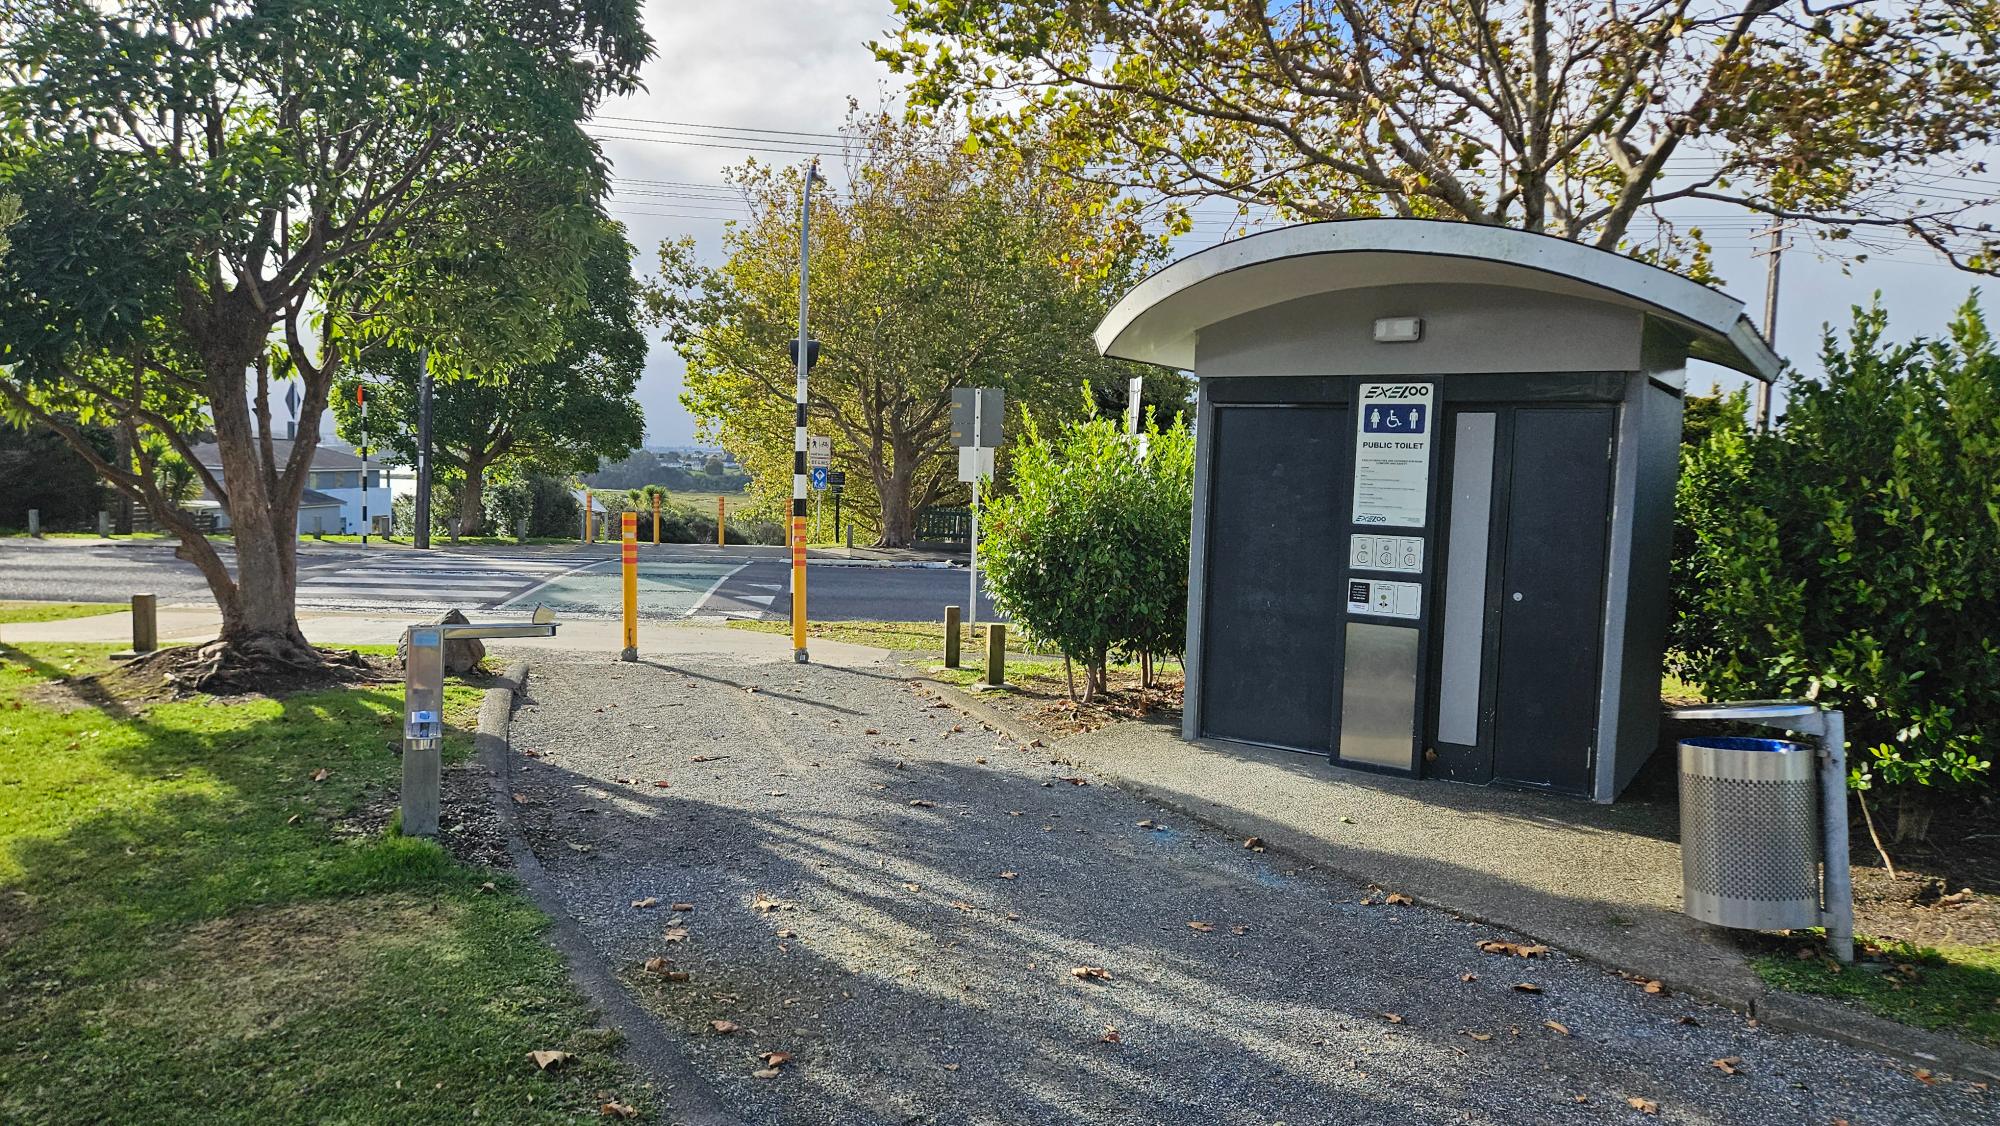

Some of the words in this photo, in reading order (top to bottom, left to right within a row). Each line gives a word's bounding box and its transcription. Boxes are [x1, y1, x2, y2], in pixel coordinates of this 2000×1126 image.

[1364, 386, 1429, 399] EXELOO
[1362, 441, 1393, 449] PUBLIC
[1394, 442, 1424, 450] TOILET
